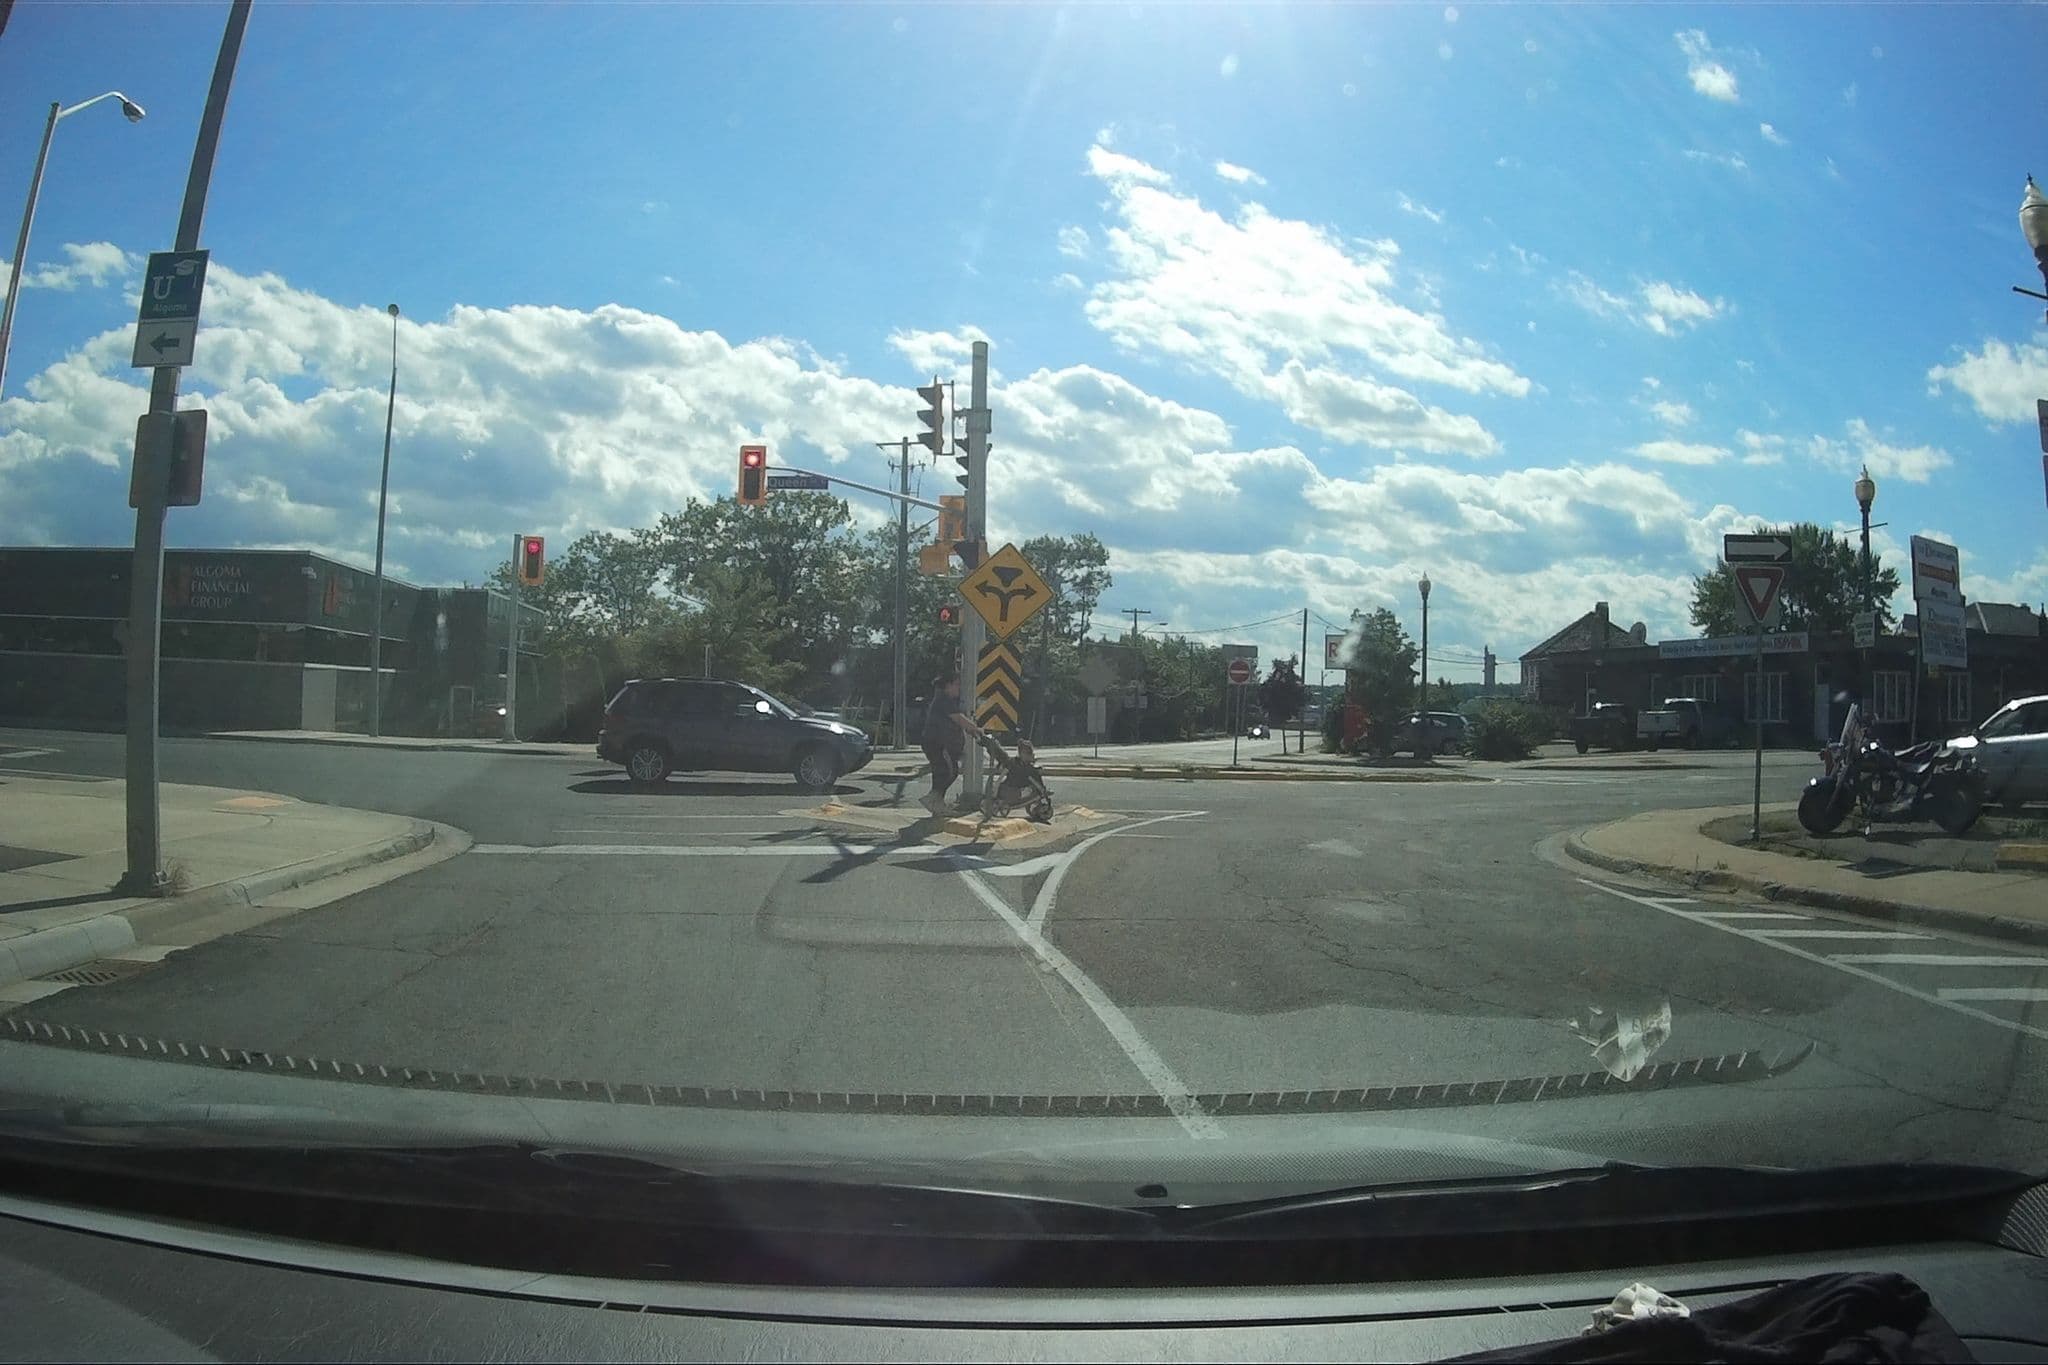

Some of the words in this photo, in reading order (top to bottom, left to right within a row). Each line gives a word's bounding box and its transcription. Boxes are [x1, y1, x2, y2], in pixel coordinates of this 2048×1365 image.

[769, 477, 807, 488] Queen
[192, 566, 242, 577] ALGOMA
[191, 580, 252, 593] FINANCIAL
[191, 596, 233, 609] GROUP
